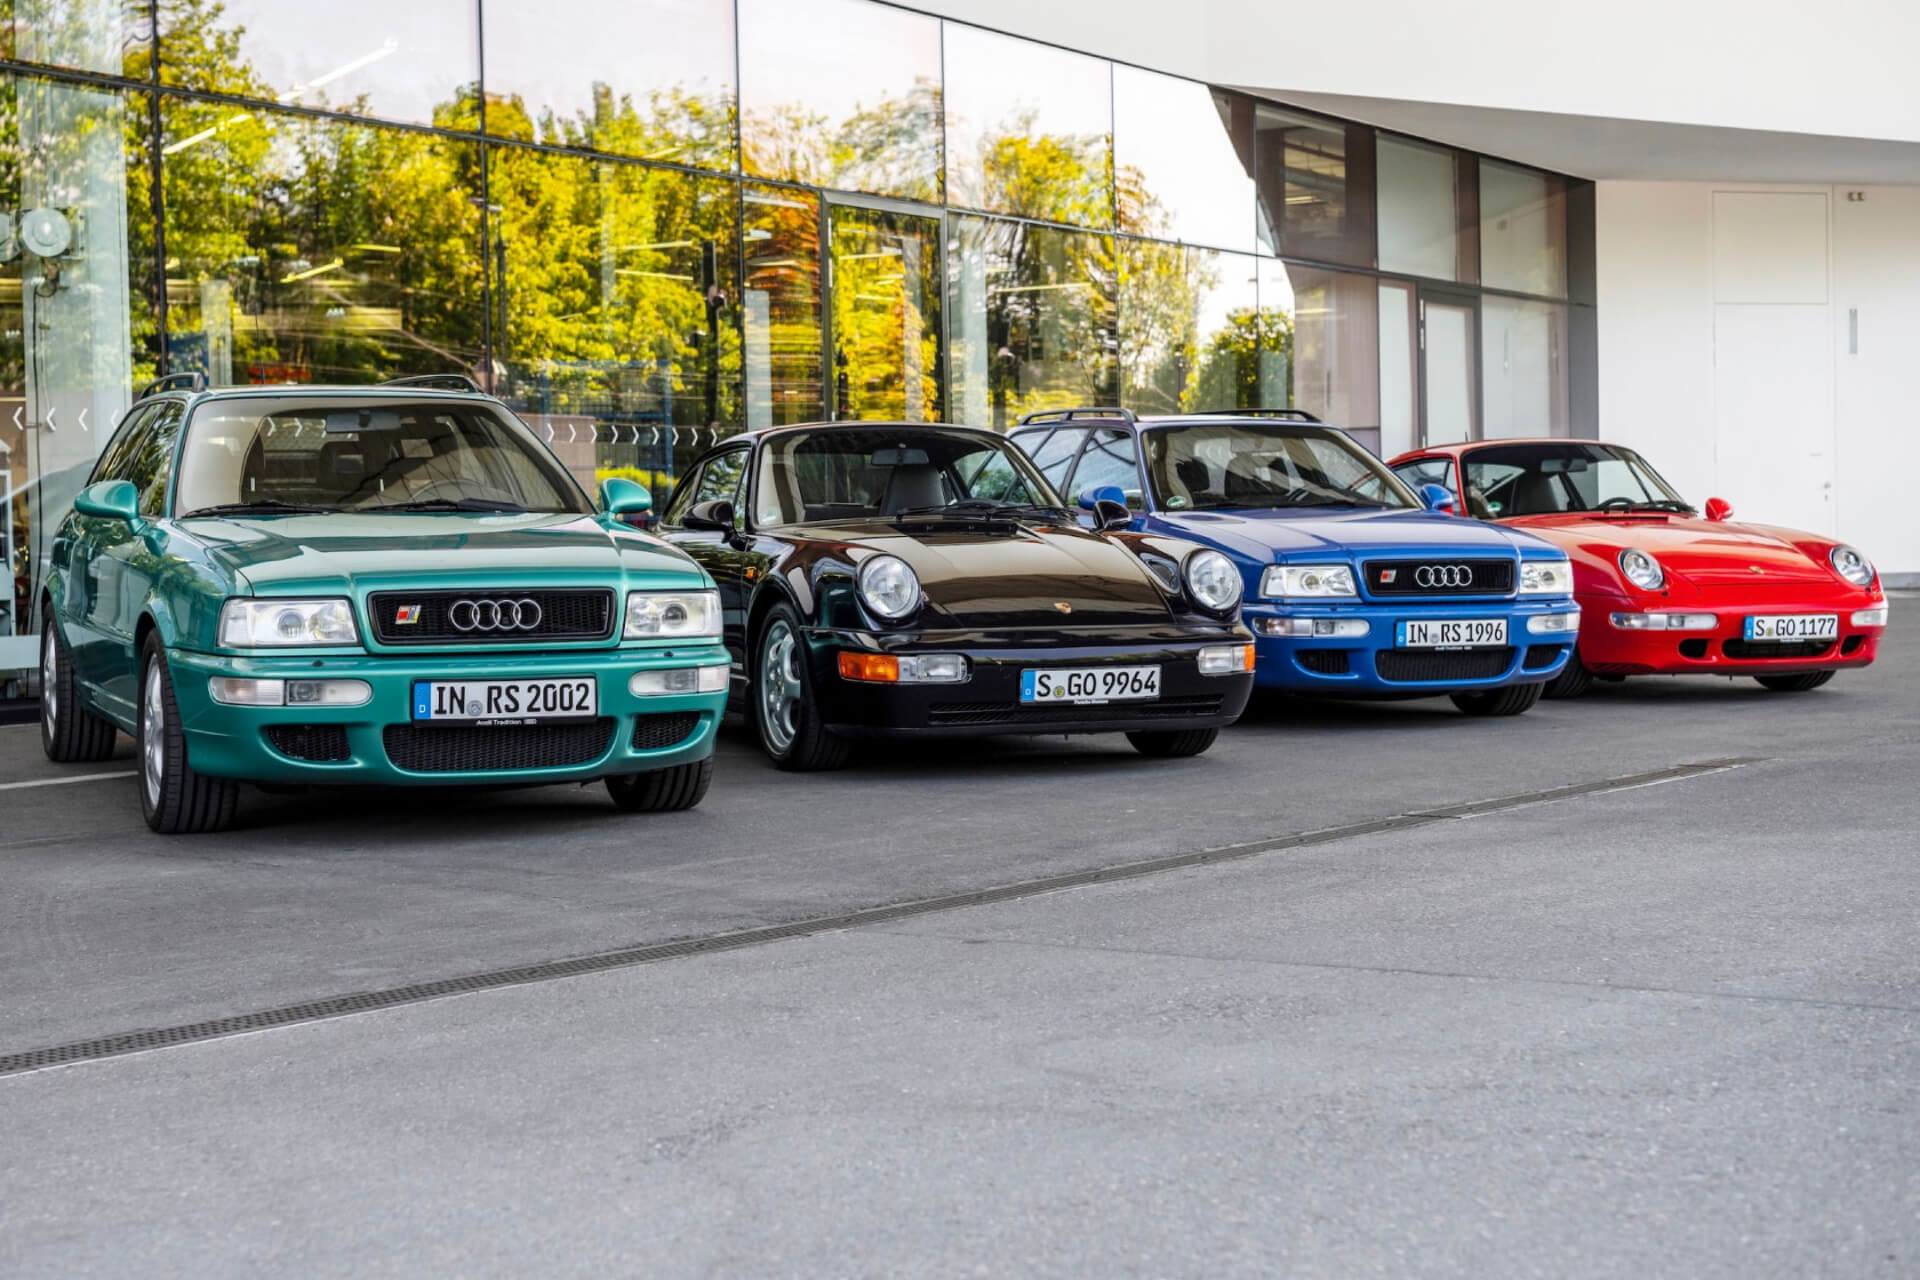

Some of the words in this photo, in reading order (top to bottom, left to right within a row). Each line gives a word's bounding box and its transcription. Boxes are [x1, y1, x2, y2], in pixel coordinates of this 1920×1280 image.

[1408, 623, 1428, 643] IN
[1441, 623, 1461, 642] RS
[1465, 622, 1503, 642] 1996
[1755, 619, 1765, 636] S
[1776, 618, 1796, 636] GO
[1799, 617, 1835, 635] 1177
[1037, 674, 1051, 697] S
[1068, 672, 1097, 696] GO
[1102, 670, 1156, 695] 9964
[419, 704, 426, 713] D
[434, 686, 466, 715] IN
[487, 685, 520, 714] RS
[526, 683, 590, 713] 2002
